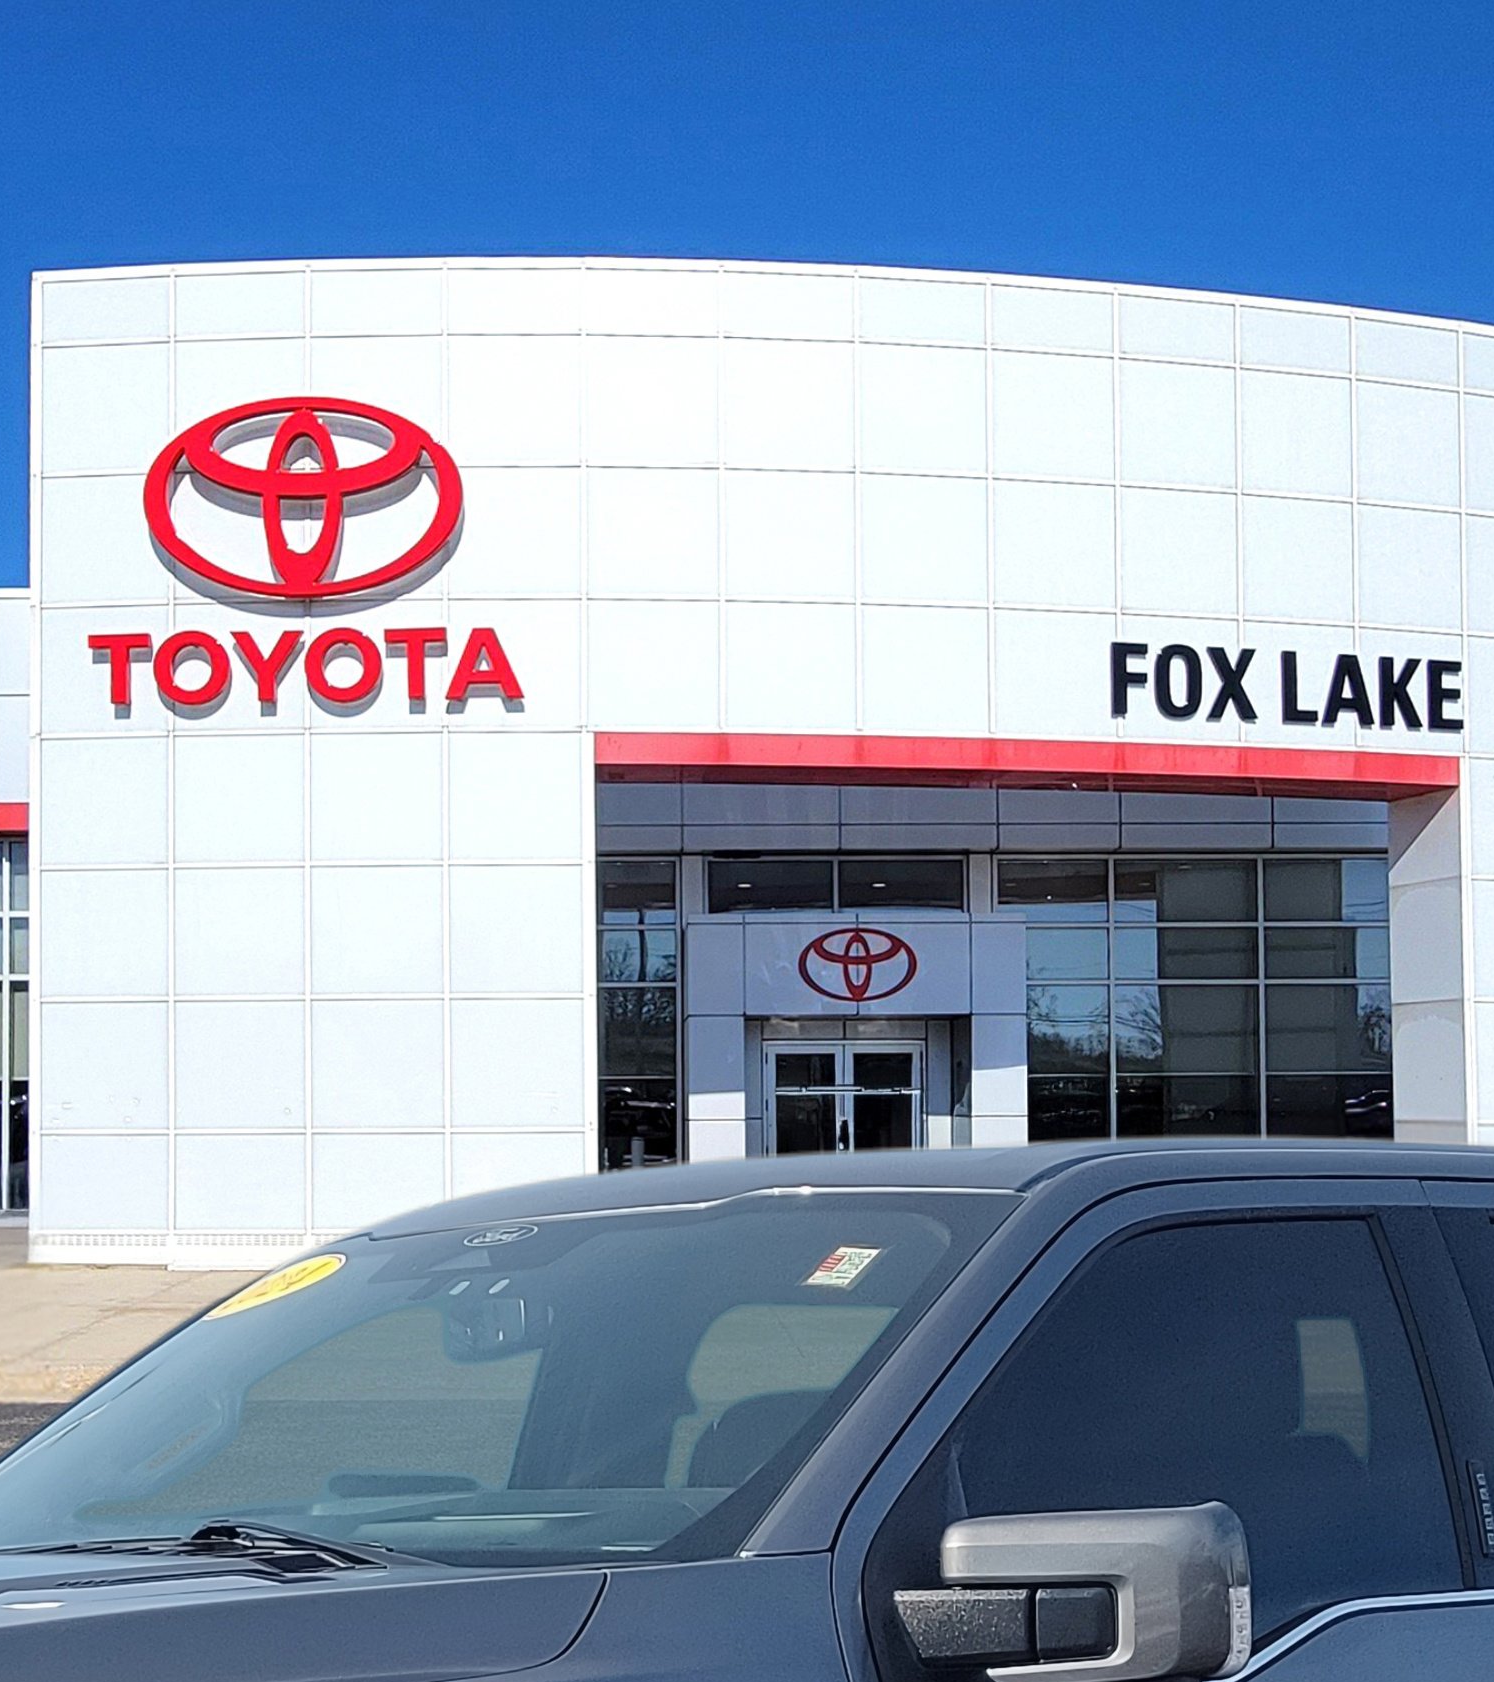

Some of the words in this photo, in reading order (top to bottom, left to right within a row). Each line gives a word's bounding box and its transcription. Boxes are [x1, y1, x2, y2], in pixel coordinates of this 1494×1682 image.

[88, 627, 525, 712] TOYOTA
[1110, 641, 1258, 723] FOX
[1279, 650, 1464, 731] LAKE
